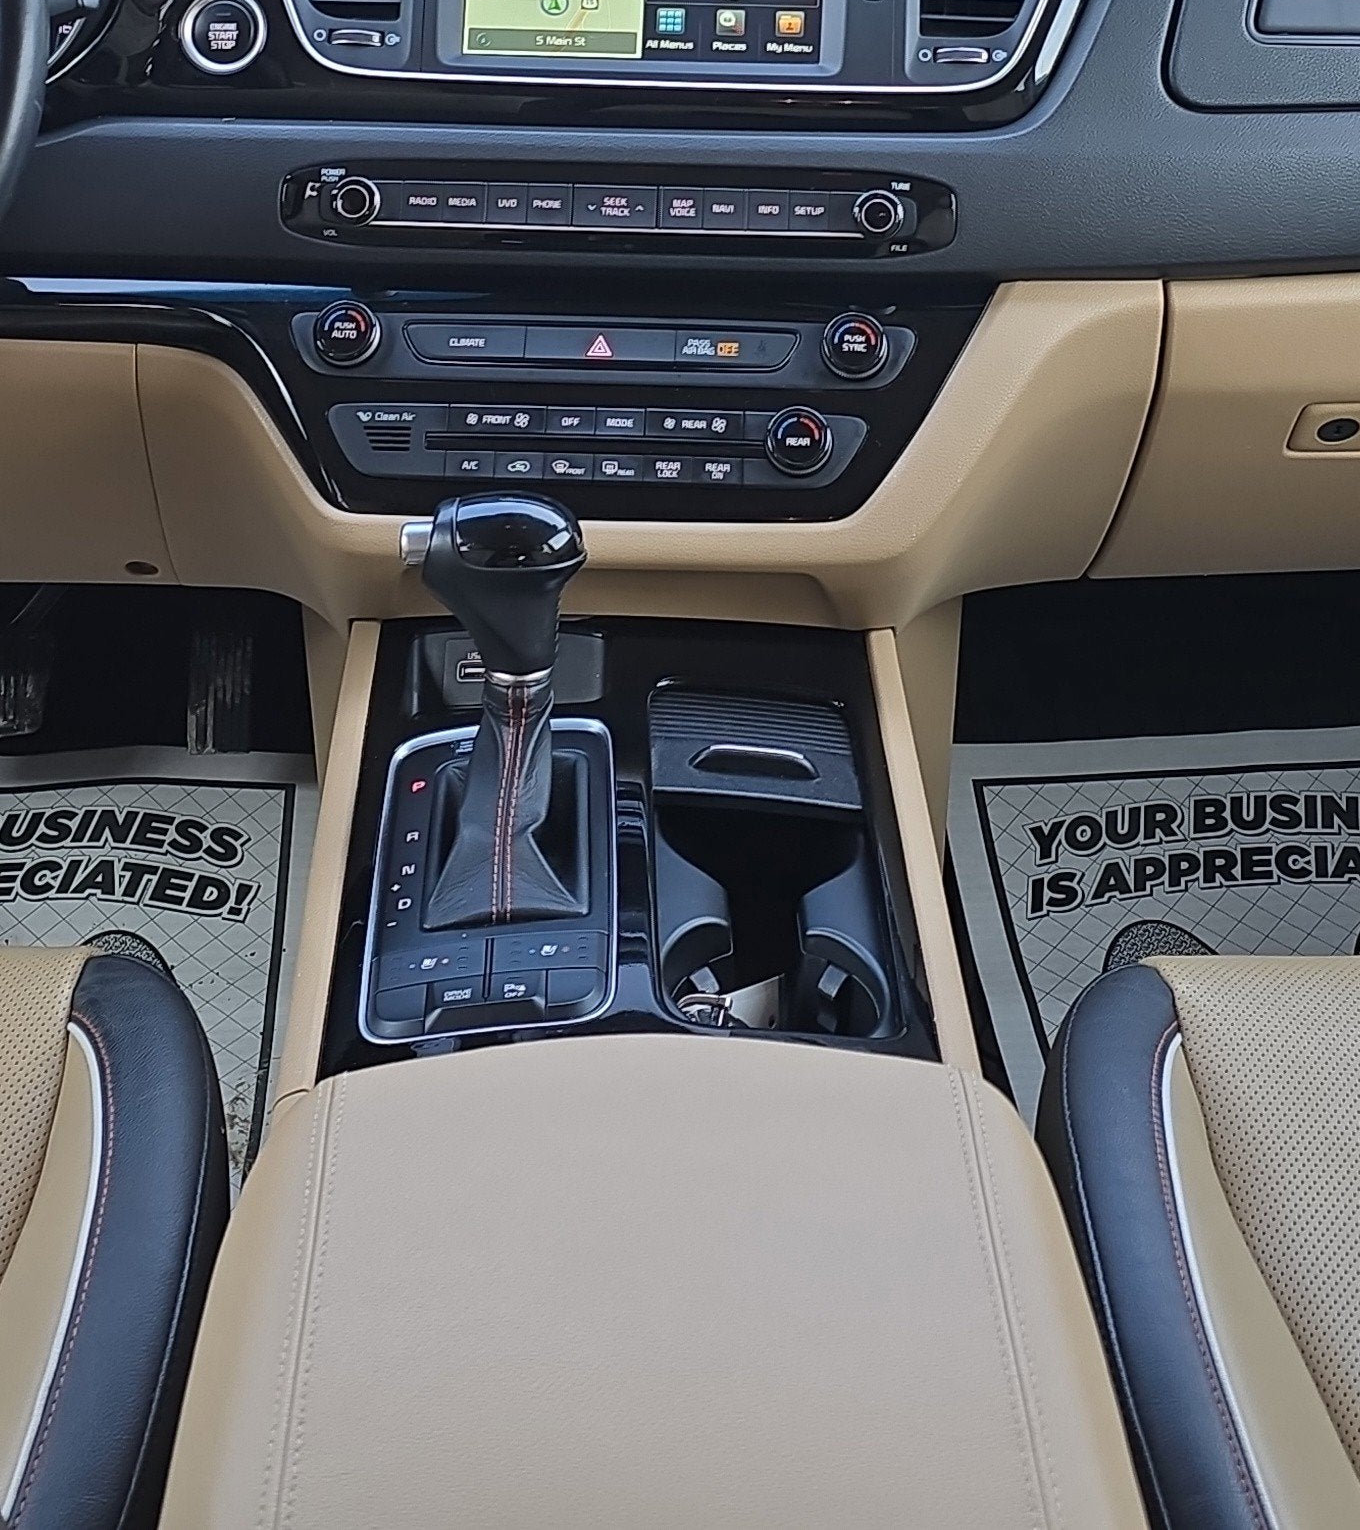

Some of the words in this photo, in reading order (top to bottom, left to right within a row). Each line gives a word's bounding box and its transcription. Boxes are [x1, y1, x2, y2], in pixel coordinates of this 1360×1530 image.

[208, 31, 239, 40] START
[210, 40, 236, 50] STOP
[546, 36, 573, 46] Main
[574, 37, 586, 46] St
[645, 40, 662, 50] All
[664, 40, 694, 51] Menus
[712, 41, 747, 52] Places
[766, 42, 785, 54] My
[786, 43, 813, 53] Menu
[408, 196, 437, 206] RADIO
[448, 197, 477, 206] MEDIA
[532, 199, 562, 209] PHONE
[603, 197, 628, 207] SEEK
[672, 199, 694, 208] MAP
[600, 206, 630, 217] TRACK
[669, 207, 696, 217] VOICE
[712, 204, 734, 214] NAVI
[758, 204, 780, 214] INFO
[794, 206, 825, 216] SETUP
[323, 228, 338, 237] VOL
[890, 244, 908, 252] FILE
[334, 321, 356, 330] PUSH
[331, 329, 357, 339] AUTO
[843, 334, 866, 343] PUSH
[449, 337, 486, 347] CLIMATE
[687, 339, 711, 348] PASS
[842, 342, 868, 352] SYNC
[717, 341, 740, 357] OFF
[374, 411, 398, 421] Clean
[399, 411, 416, 421] Air
[481, 414, 512, 424] FRONT
[561, 417, 580, 427] OFF
[606, 418, 634, 428] MODE
[681, 420, 707, 430] REAR
[785, 437, 810, 447] REAR
[461, 460, 479, 470] A/C
[655, 461, 681, 470] REAR
[705, 462, 731, 472] REAR
[657, 470, 679, 479] LOCK
[411, 780, 427, 793] P
[406, 831, 420, 842] R
[1026, 800, 1185, 866] YOUR
[401, 864, 416, 876] N
[1026, 872, 1086, 921] IS
[397, 897, 412, 910] D
